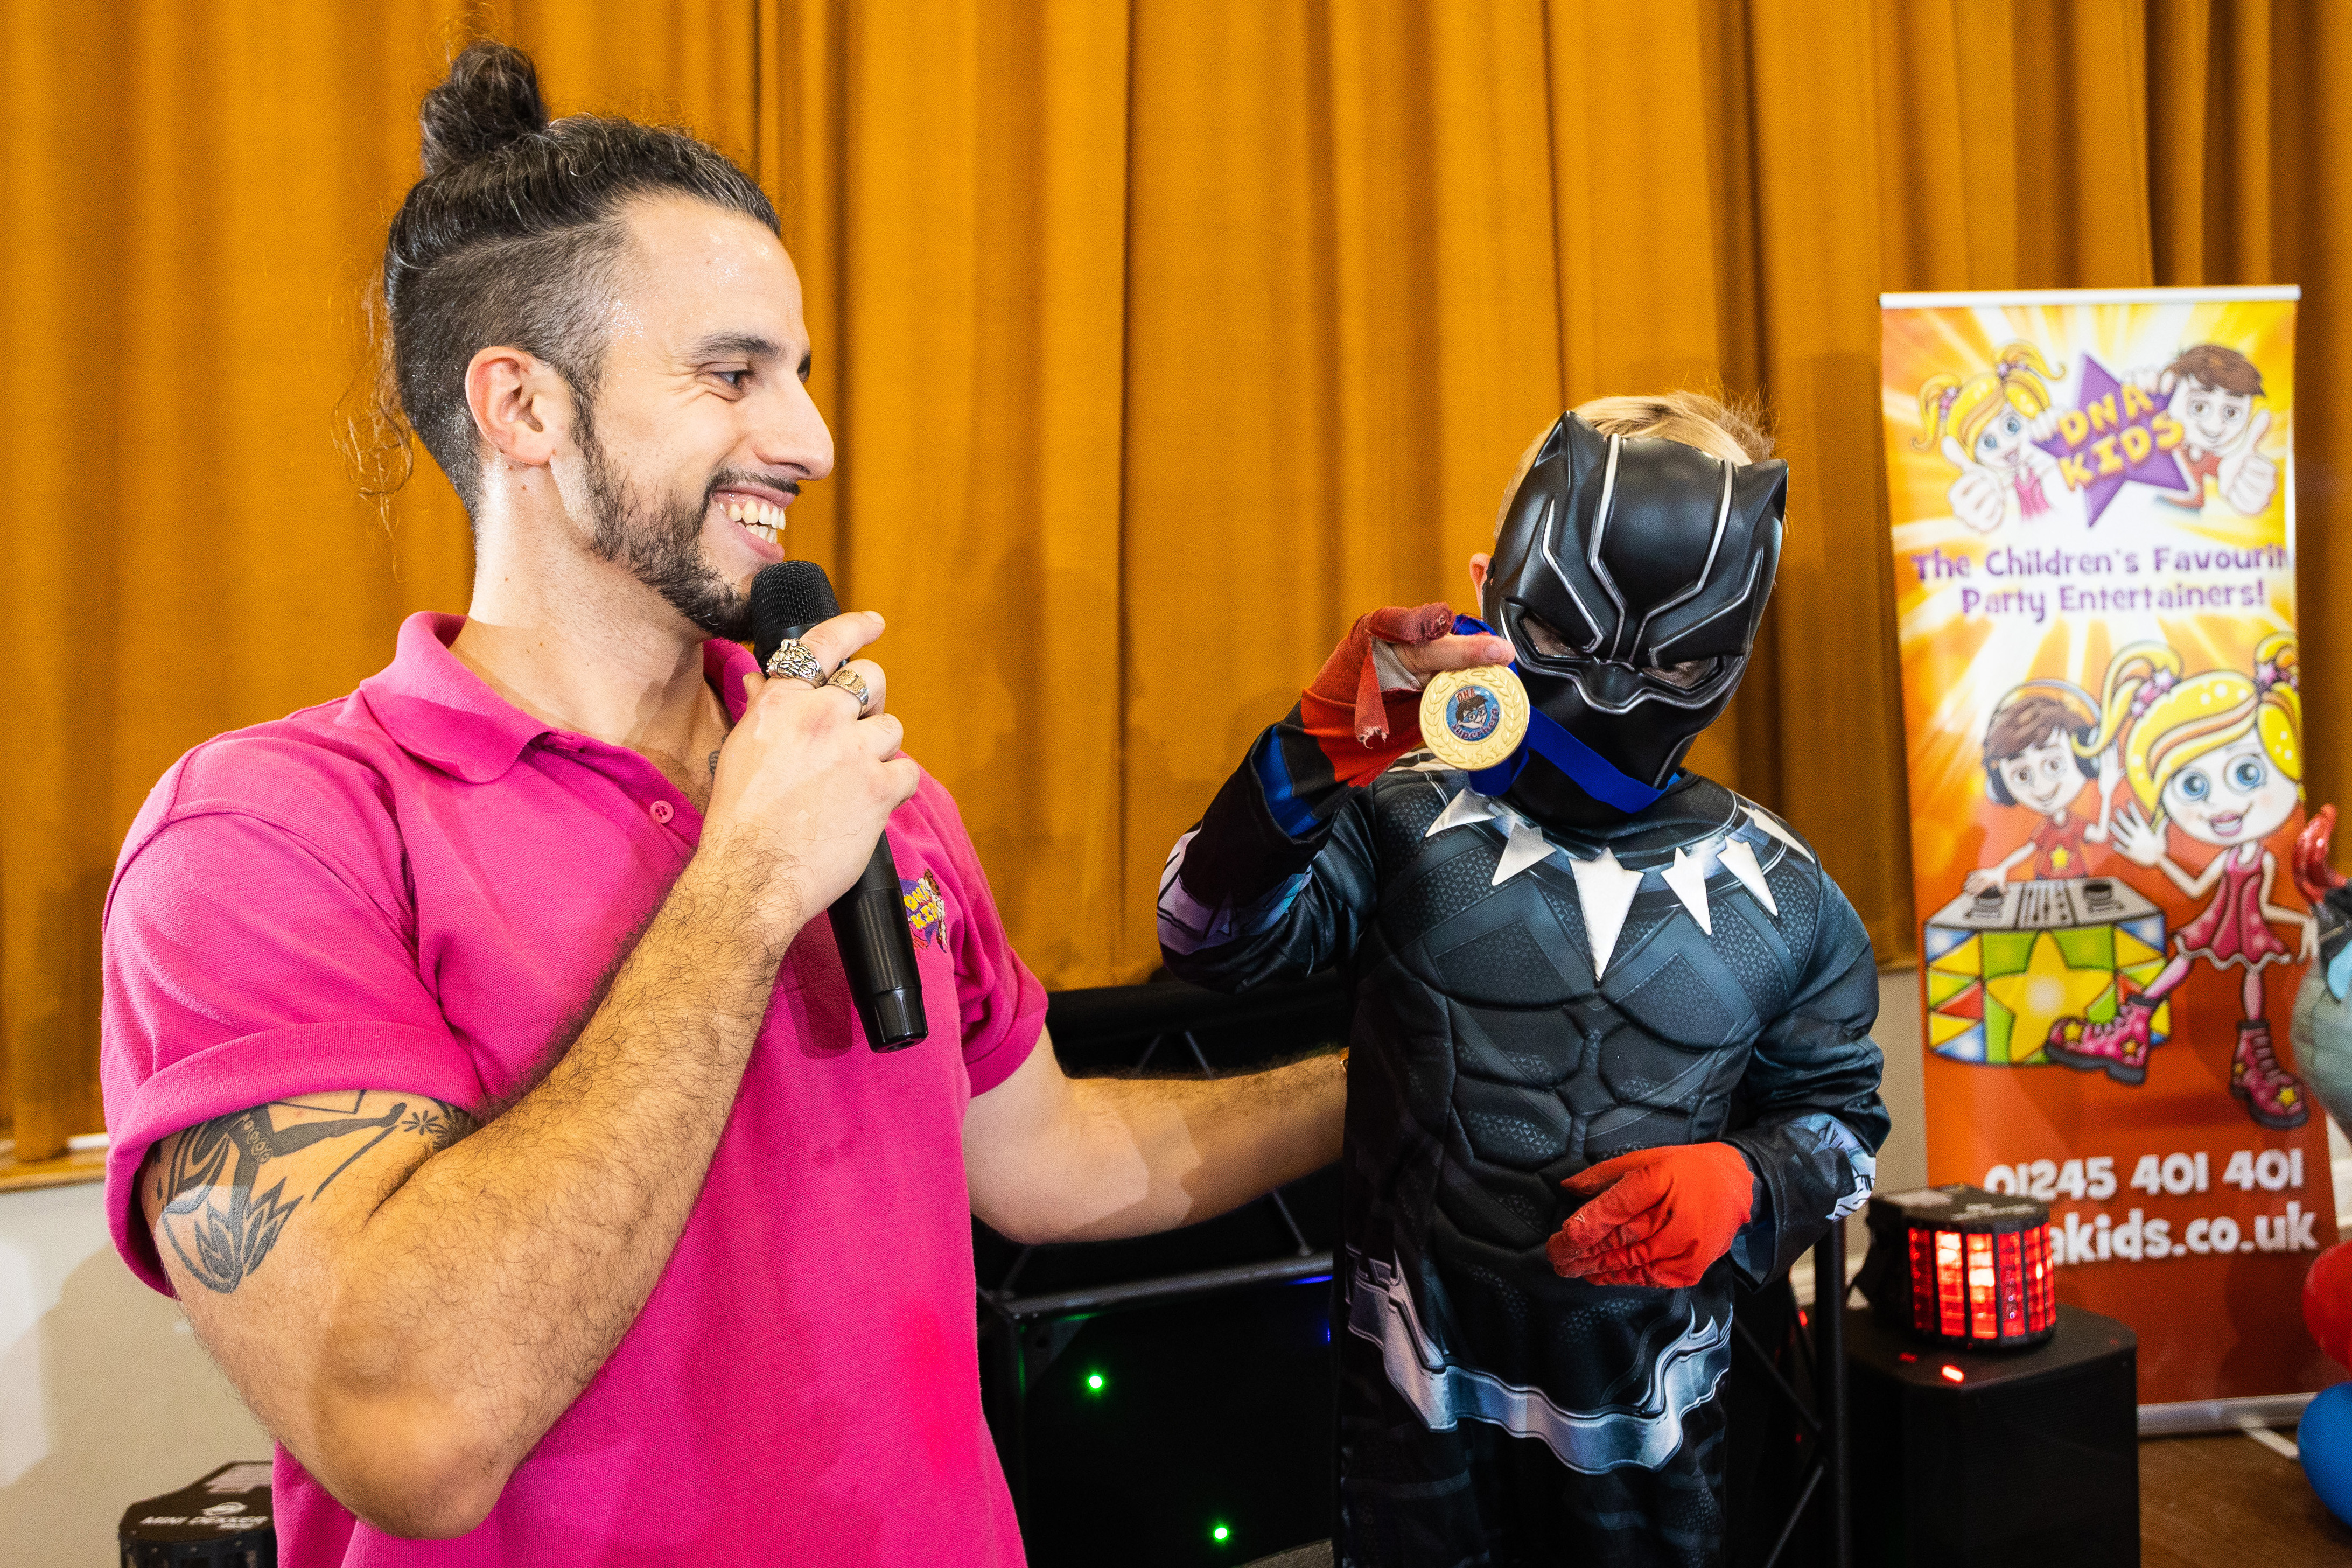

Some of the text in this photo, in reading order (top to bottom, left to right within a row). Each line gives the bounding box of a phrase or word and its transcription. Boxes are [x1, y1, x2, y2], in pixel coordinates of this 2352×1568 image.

[2057, 383, 2154, 448] DNA
[2057, 412, 2185, 492] KIDS
[1910, 543, 2287, 580] The Children's Favourit
[1961, 576, 2265, 624] Party Entertainers!
[1984, 1147, 2304, 1201] 01245 401 401
[2049, 1200, 2319, 1265] akids.co.uk
